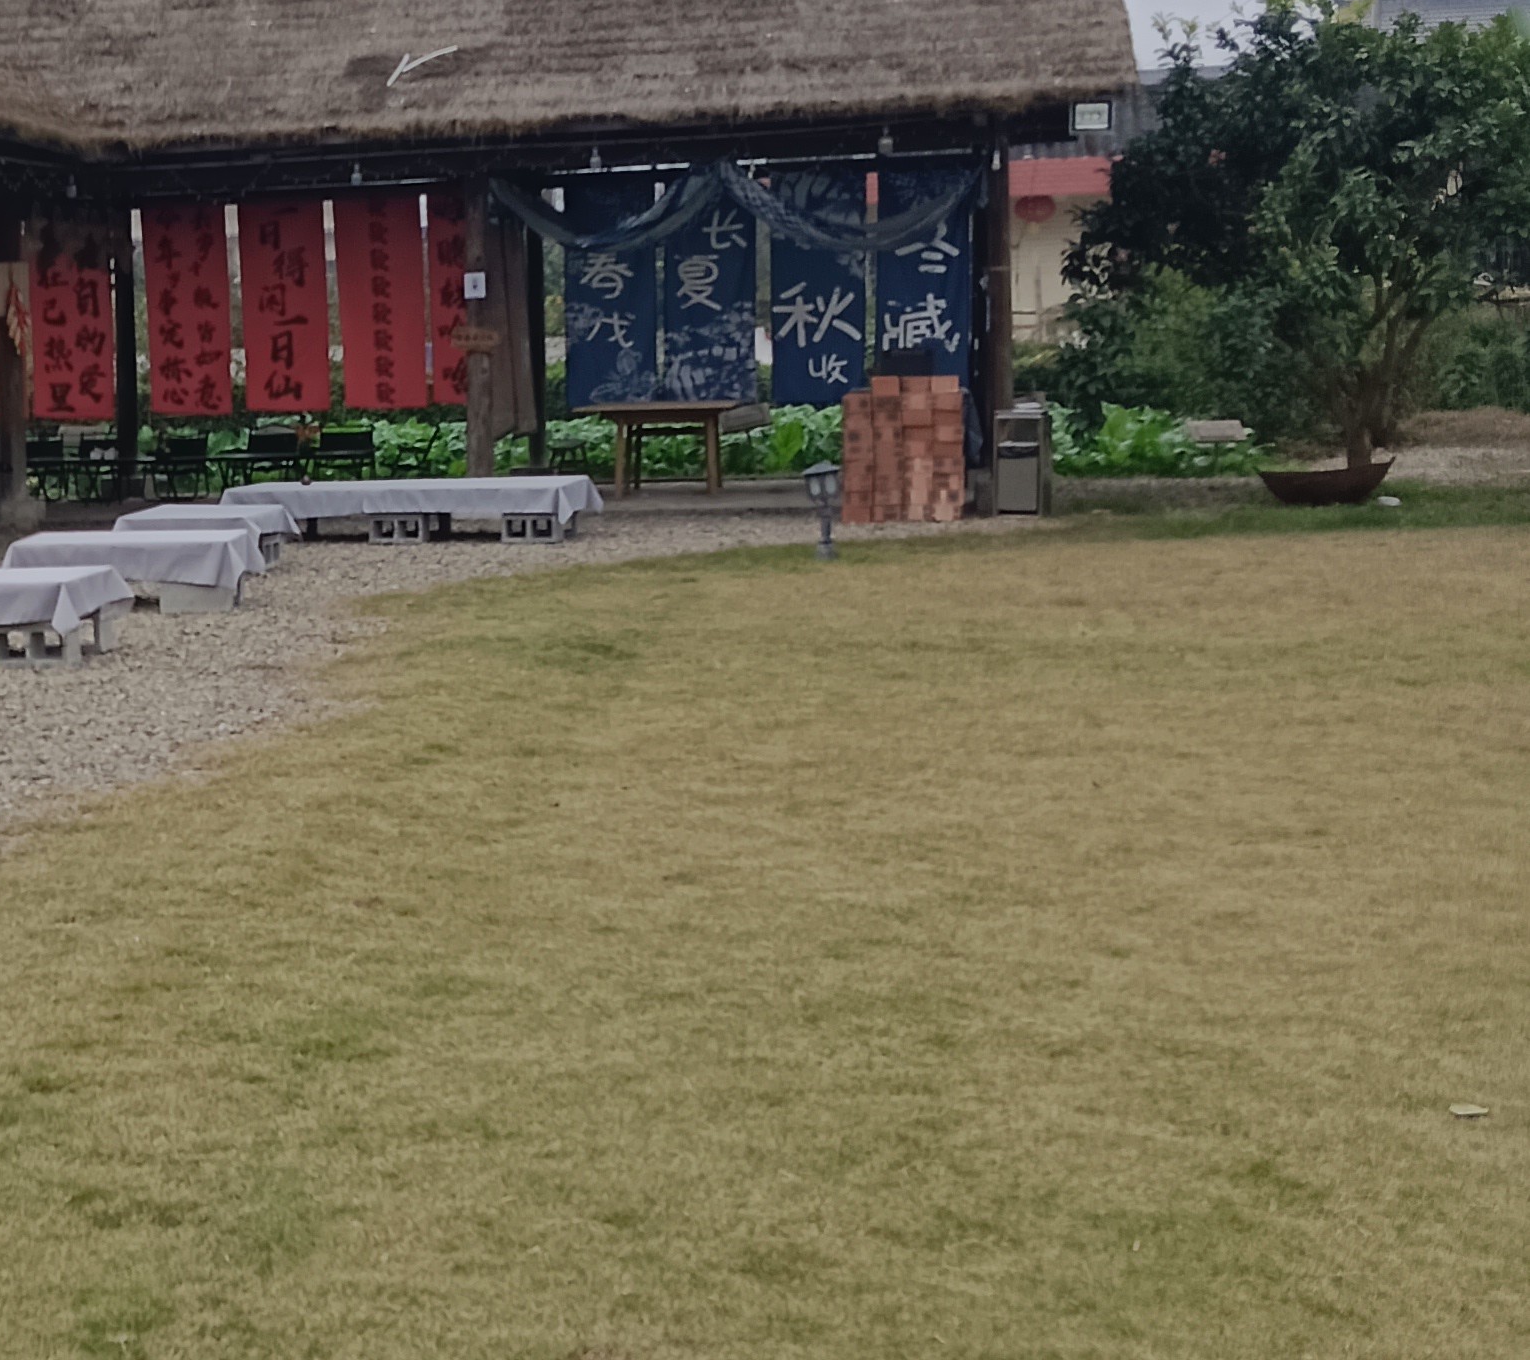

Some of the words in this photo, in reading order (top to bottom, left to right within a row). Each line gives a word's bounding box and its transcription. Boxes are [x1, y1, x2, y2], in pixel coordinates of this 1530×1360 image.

[258, 205, 309, 402] 一日得闲一日仙
[676, 208, 747, 311] 长夏
[773, 281, 863, 384] 秋收
